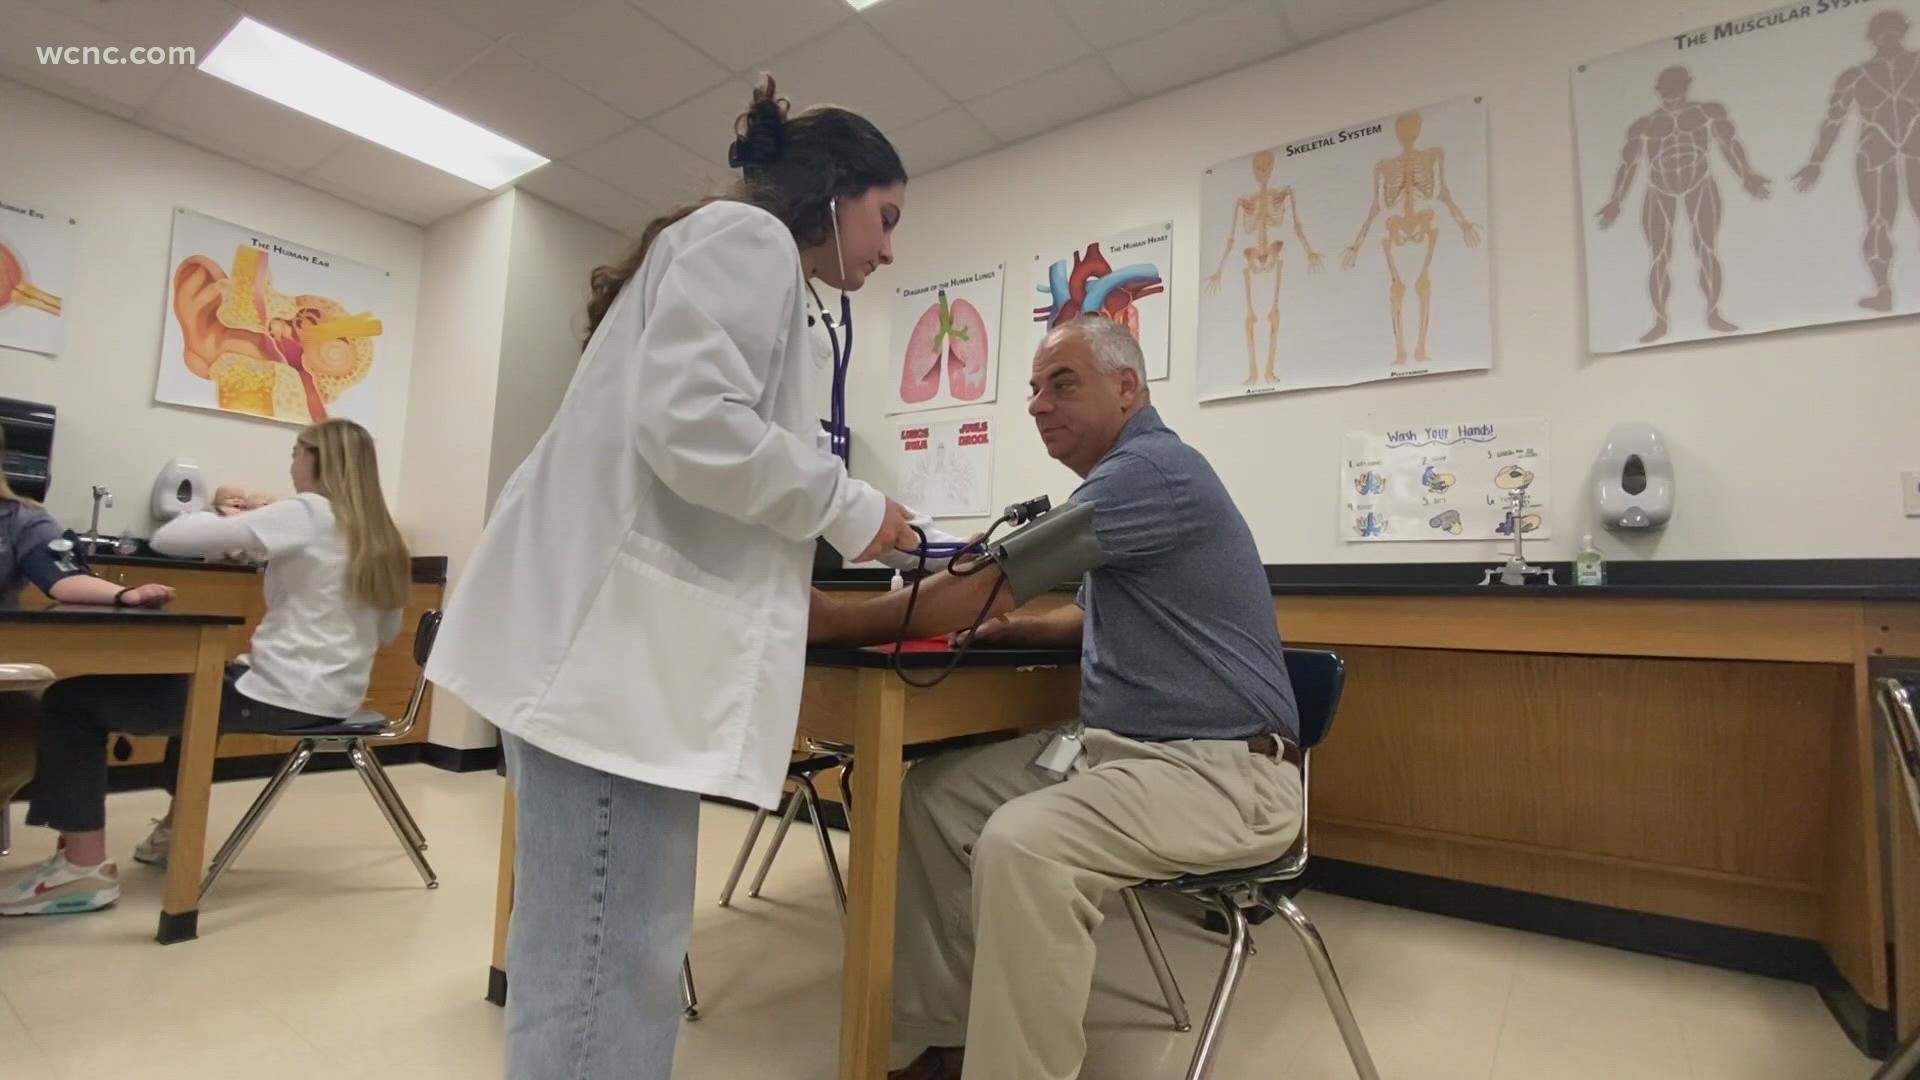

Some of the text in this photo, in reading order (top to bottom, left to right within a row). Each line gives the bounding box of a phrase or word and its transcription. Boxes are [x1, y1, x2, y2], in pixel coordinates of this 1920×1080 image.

[1673, 0, 1873, 50] THE MUSCULAR SYS
[1286, 124, 1382, 157] SKELETAL SYSTEM
[251, 238, 330, 267] THE HUMAN EAR
[951, 278, 974, 287] HUMAN
[1387, 429, 1417, 443] Wash
